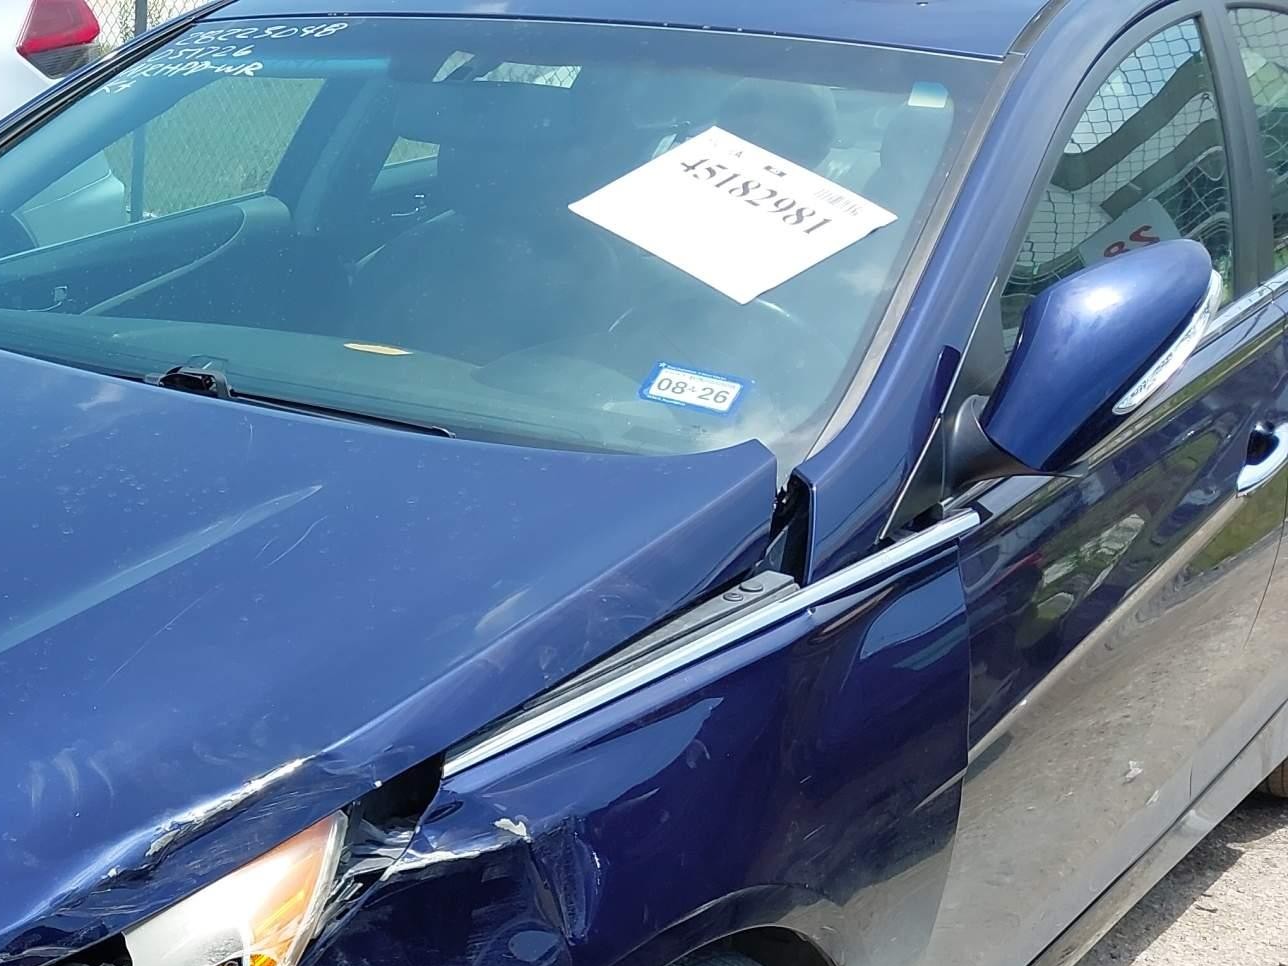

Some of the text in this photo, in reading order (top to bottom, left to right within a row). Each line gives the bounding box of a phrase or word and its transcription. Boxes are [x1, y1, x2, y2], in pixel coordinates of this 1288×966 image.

[680, 157, 833, 235] 45182981
[656, 377, 688, 395] 08
[697, 386, 731, 404] 26
